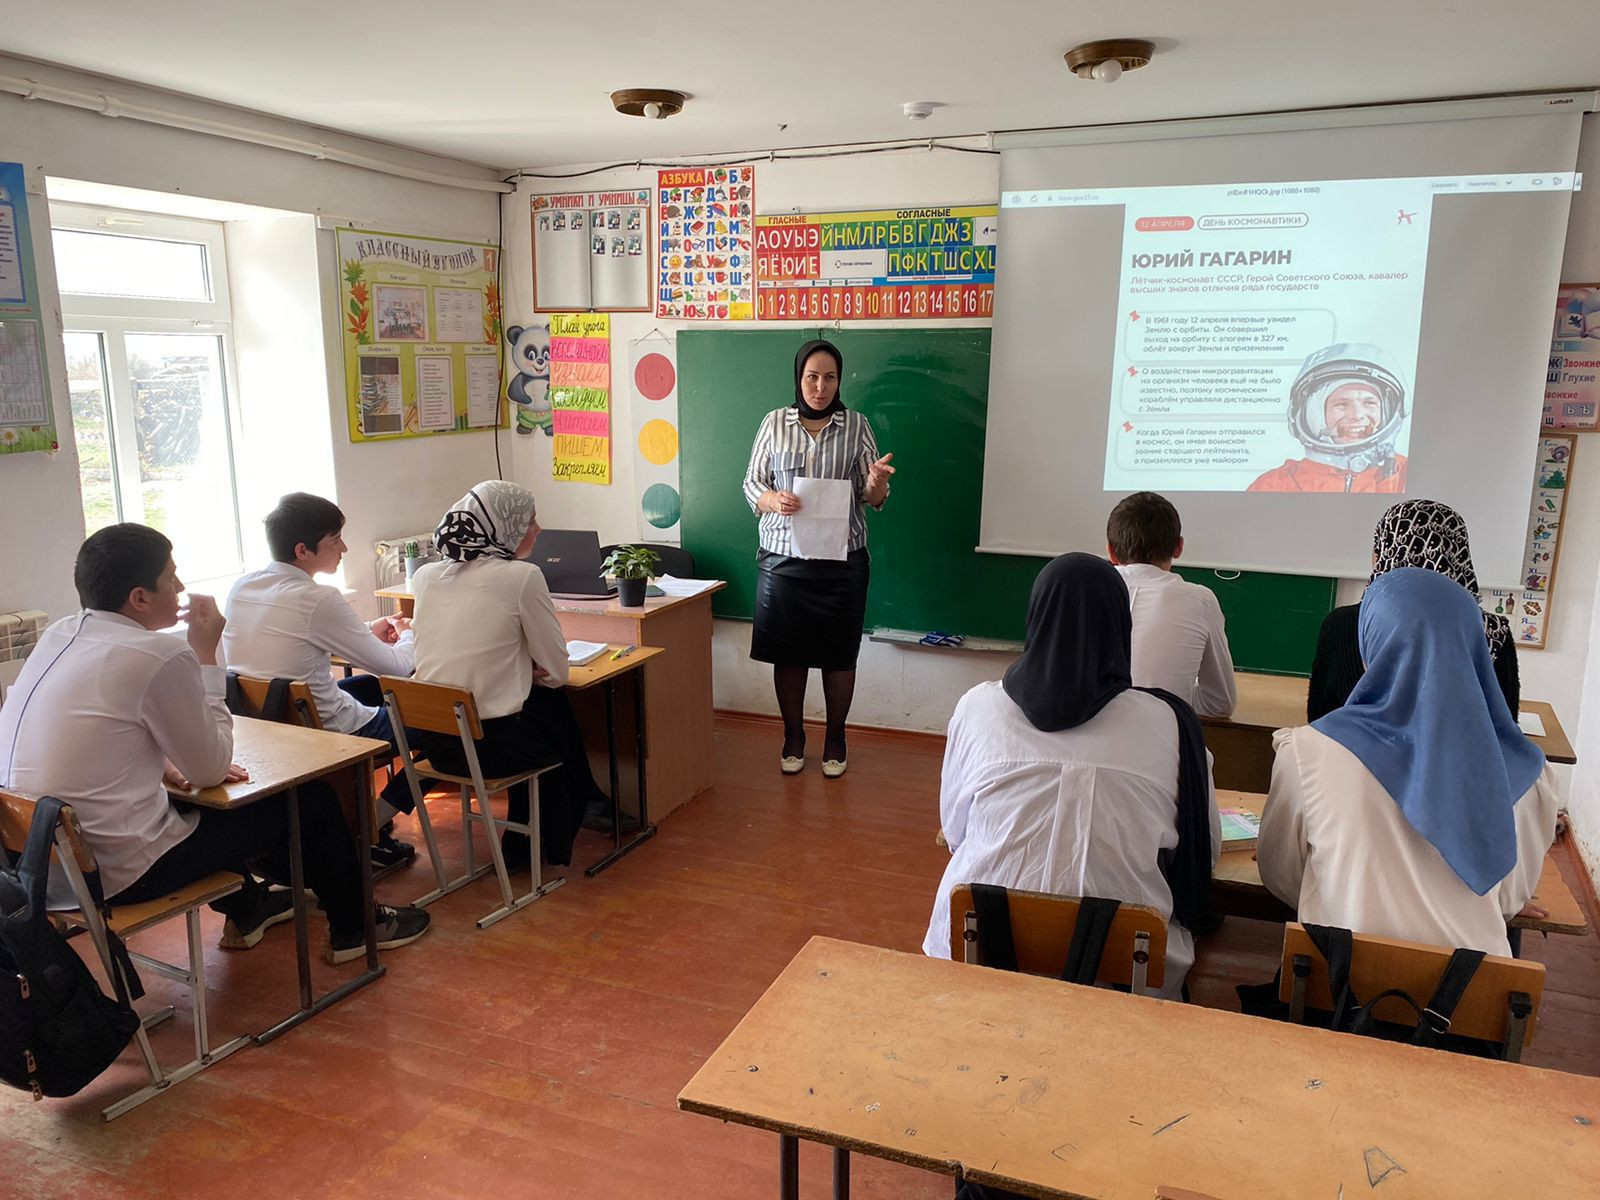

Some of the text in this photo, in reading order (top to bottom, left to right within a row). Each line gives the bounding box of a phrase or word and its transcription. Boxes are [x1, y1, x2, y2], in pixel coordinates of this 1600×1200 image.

[661, 169, 738, 185] АЗБУКА А Б
[550, 192, 635, 208] УМНИКИ И УМНИЦЫ
[661, 190, 669, 204] В
[683, 189, 691, 203] Г
[706, 187, 716, 203] Д
[661, 204, 738, 221] Ё Ж З И
[768, 215, 807, 225] ГЛАСНЫЕ
[896, 208, 952, 219] СОГЛАСНЫЕ
[661, 220, 740, 237] Й К Л М
[1151, 219, 1185, 228] АПРЕЛЯ
[1202, 216, 1302, 228] ДЕНЬ КОСМОНАВТИКИ
[683, 239, 692, 253] О
[706, 238, 715, 252] П
[729, 237, 737, 252] Р
[661, 255, 668, 269] С
[706, 254, 715, 269] У
[729, 254, 741, 268] Ф
[1132, 249, 1292, 268] ЮРИЙ ГАГАРИН
[661, 271, 742, 287] Х Ц Ч Ш
[1217, 275, 1245, 285] СССР,
[1246, 273, 1274, 284] Герой
[1276, 273, 1330, 283] Советского
[1333, 272, 1366, 282] Союза,
[1368, 272, 1409, 281] кавалер
[660, 288, 673, 303] Щ
[707, 291, 717, 302] Ы
[1130, 286, 1166, 294] высших
[1242, 284, 1264, 293] ряда
[1266, 282, 1319, 292] государств
[758, 290, 994, 315] 0 1 2 3 4 5 6 7 8 9 10 11 12 13 14 15 16 17
[659, 303, 715, 318] Э Ю Я
[552, 314, 580, 335] План
[1171, 317, 1189, 325] году
[1267, 316, 1296, 324] увидел
[1563, 358, 1600, 368] Звонкие
[1563, 372, 1596, 384] Глухие
[1161, 428, 1185, 436] Юрий
[1186, 428, 1217, 436] Гагарин
[556, 434, 604, 457] ПИШЕМ
[552, 456, 607, 480] Закрепляем
